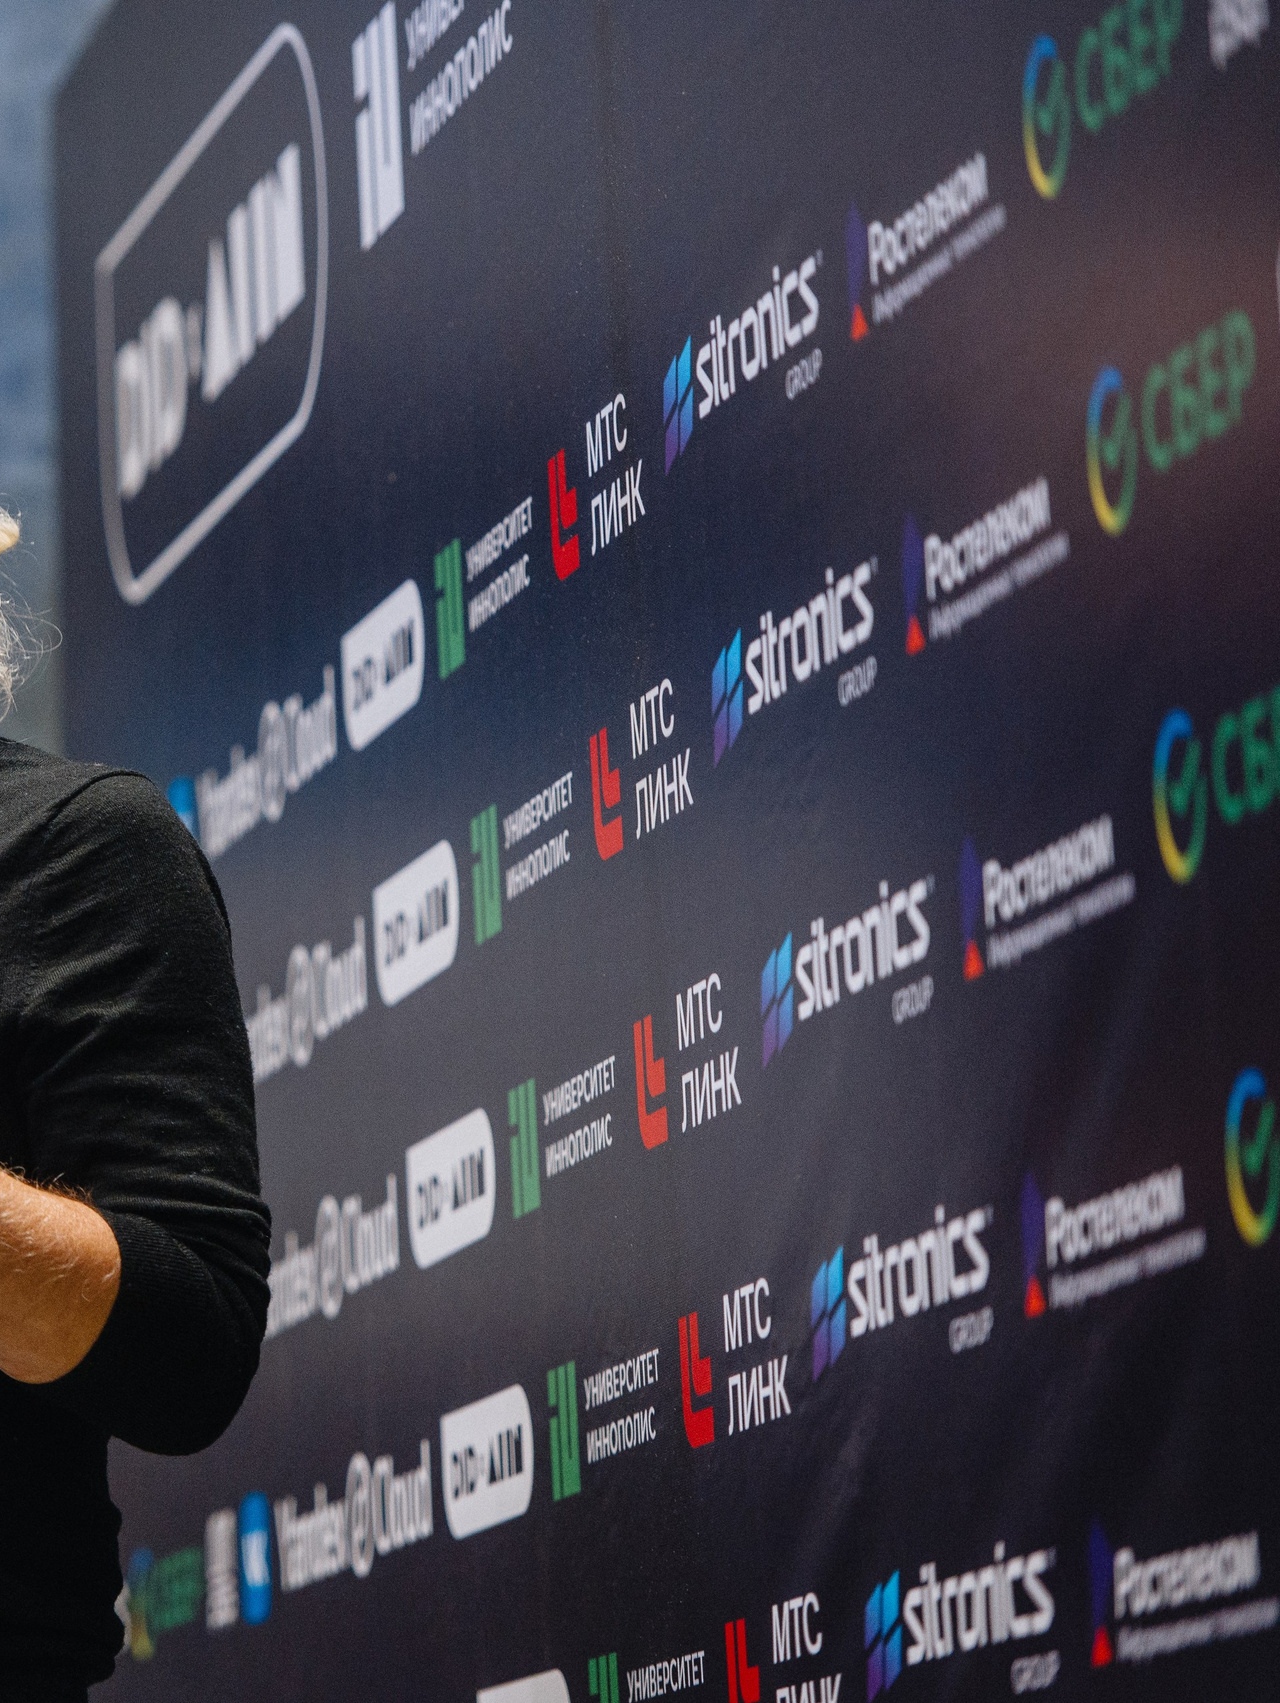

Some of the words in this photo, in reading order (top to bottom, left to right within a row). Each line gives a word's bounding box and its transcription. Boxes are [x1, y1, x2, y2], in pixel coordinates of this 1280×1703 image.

[696, 256, 819, 420] sitronics
[785, 348, 823, 400] GROUP
[1141, 308, 1256, 474] СБЕР
[586, 393, 628, 477] МТС
[591, 459, 646, 556] ЛИНК
[745, 561, 874, 715] sitronics
[629, 678, 675, 760] МТС
[838, 656, 877, 706] GROUP
[503, 770, 574, 850] УНИВЕРСИТЕТ
[634, 748, 694, 840] ЛИНК
[506, 829, 571, 901] ИННОПОЛИС
[795, 880, 930, 1021] sitronics
[676, 972, 723, 1051] МТС
[543, 1055, 615, 1127] УНИВЕРСИТЕТ
[681, 1046, 742, 1133] ЛИНК
[545, 1112, 613, 1179] ИННОПОЛИС
[847, 1204, 990, 1339] sitronics
[722, 1278, 772, 1353] МТС
[583, 1348, 659, 1411] УНИВЕРСИТЕТ
[728, 1354, 791, 1436] ЛИНК
[586, 1406, 656, 1464] ИННОПОЛИС
[371, 1438, 433, 1557] Cloud
[772, 1593, 823, 1664] МТС
[903, 1540, 1056, 1667] sitronics
[626, 1650, 705, 1703] УНИВЕРСИТЕТ
